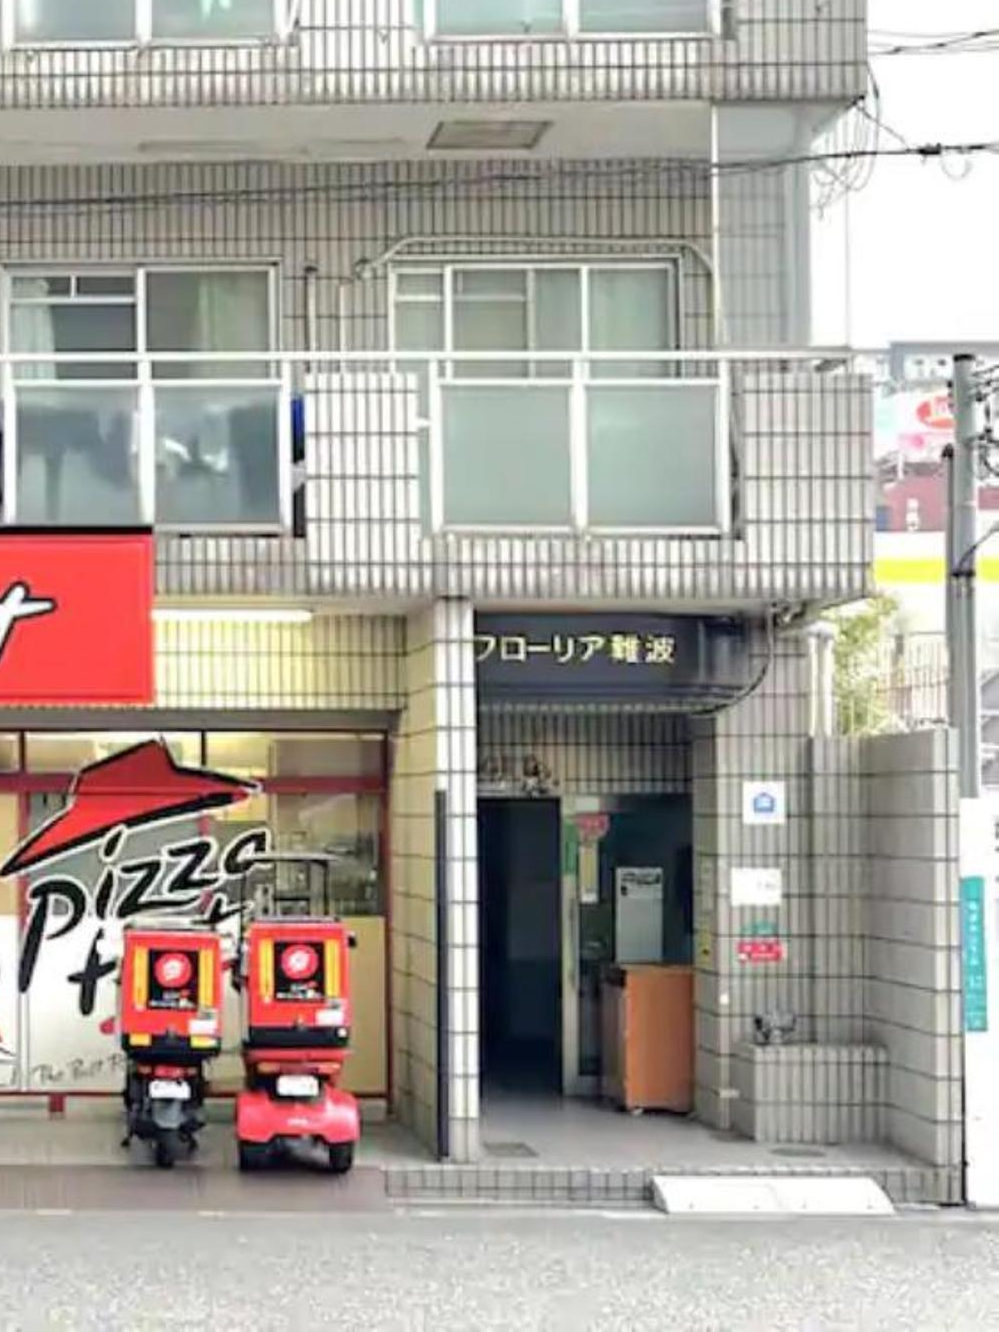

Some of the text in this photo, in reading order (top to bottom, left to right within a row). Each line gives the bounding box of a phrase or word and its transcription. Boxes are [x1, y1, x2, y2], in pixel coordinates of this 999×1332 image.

[474, 634, 675, 663] フローリア難波
[18, 824, 271, 994] Pizza
